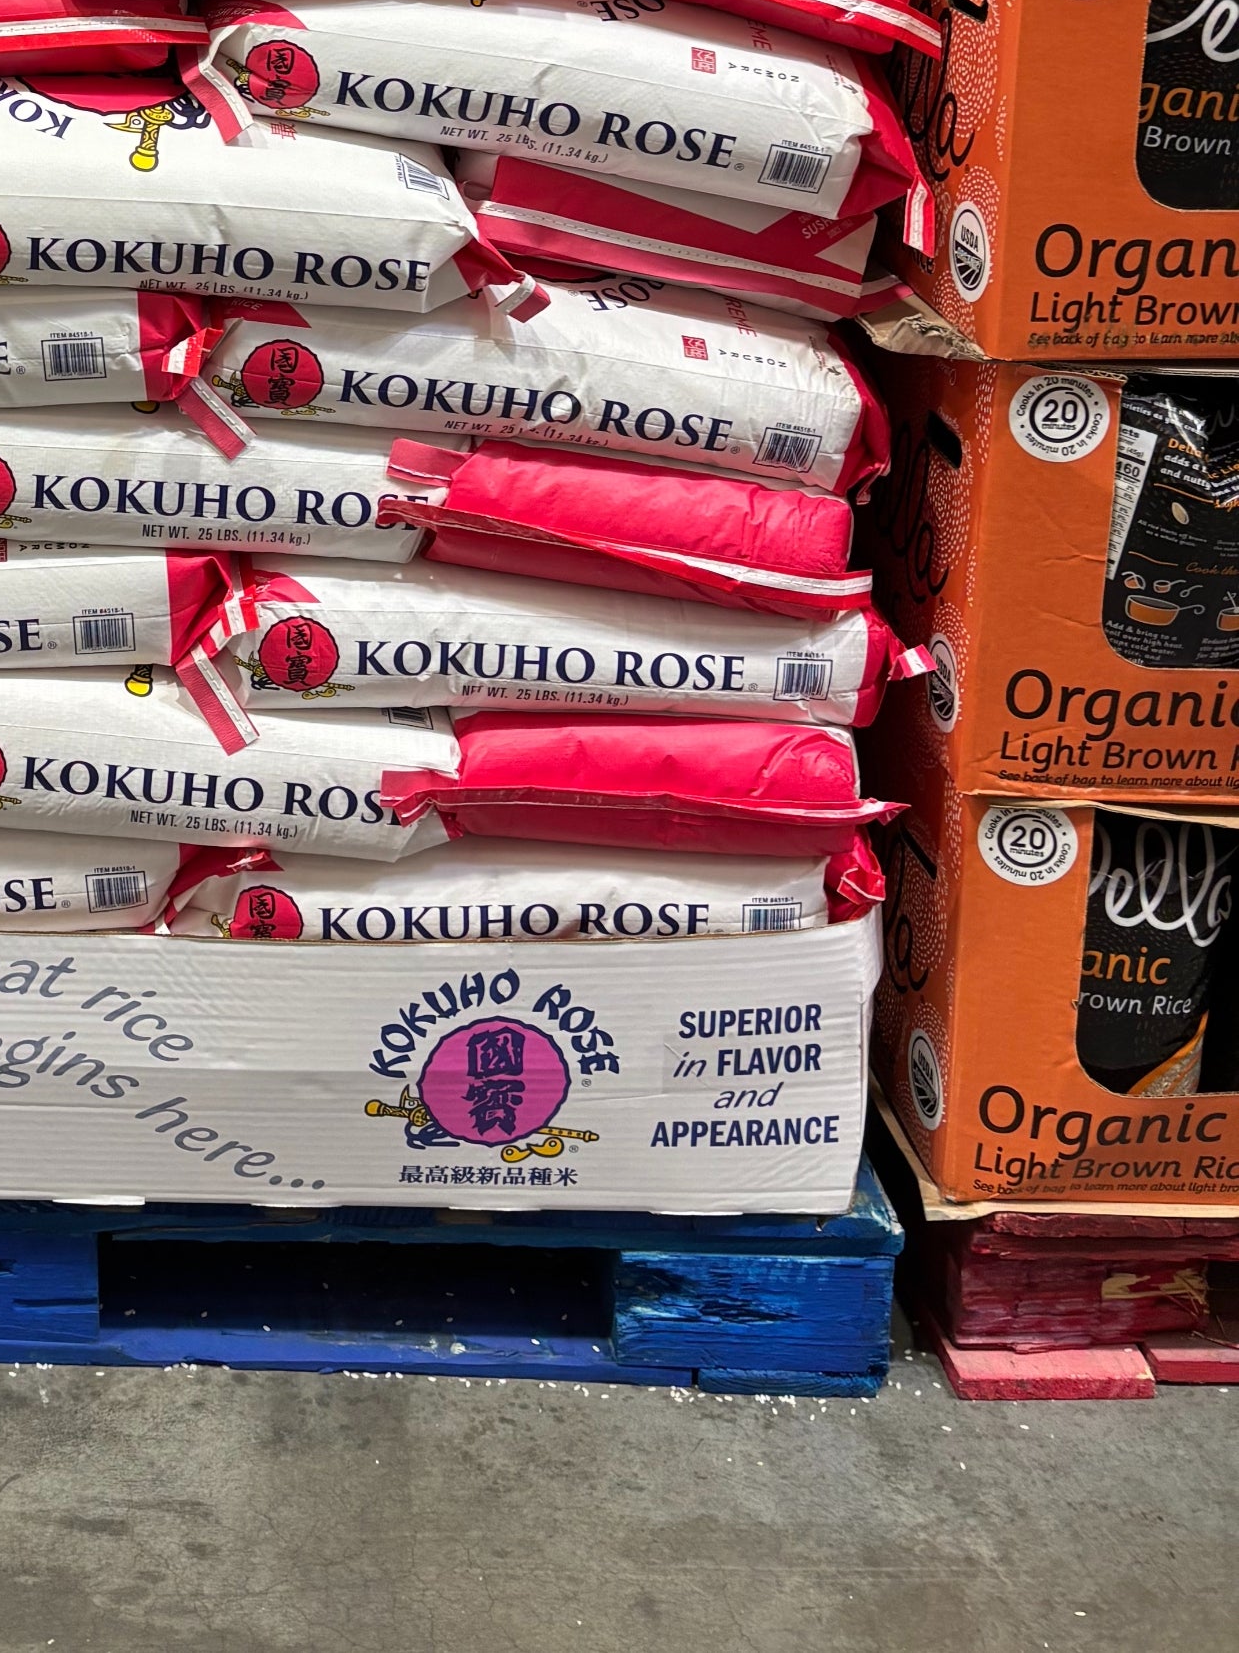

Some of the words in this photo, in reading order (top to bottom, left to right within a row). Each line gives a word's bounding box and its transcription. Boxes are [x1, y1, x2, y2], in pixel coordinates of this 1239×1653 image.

[335, 69, 580, 136] KOKUHO
[598, 110, 736, 171] ROSE
[1143, 125, 1231, 155] Brown
[960, 224, 978, 250] USDA
[26, 237, 286, 279] KOKUHO
[294, 251, 431, 293] ROSE
[1030, 292, 1123, 333] Light
[339, 368, 581, 425] KOKUHO
[599, 398, 732, 453] ROSE
[356, 640, 596, 685] KOKUHO
[614, 650, 746, 692] ROSE
[999, 731, 1092, 774] Light
[1103, 742, 1218, 770] Brown
[998, 770, 1022, 781] See
[1024, 771, 1053, 784] back
[1054, 773, 1068, 786] of
[1070, 772, 1096, 787] bag
[1100, 775, 1113, 785] to
[1116, 774, 1147, 786] learn
[1150, 776, 1182, 787] more
[1185, 774, 1220, 786] about
[80, 986, 194, 1062] rice
[368, 967, 521, 1080] KOKUHO
[532, 983, 621, 1077] ROSE
[679, 1004, 822, 1039] SUPERIOR
[1152, 995, 1192, 1016] Rice
[673, 1053, 708, 1079] in
[717, 1043, 822, 1077] FLAVOR
[713, 1082, 785, 1110] and
[134, 1096, 325, 1190] here...
[651, 1115, 839, 1148] APPEARANCE
[979, 1084, 1227, 1160] Organic
[398, 1164, 578, 1187] 最高級新品種米
[974, 1142, 1062, 1186] Light
[1072, 1157, 1181, 1179] Brown
